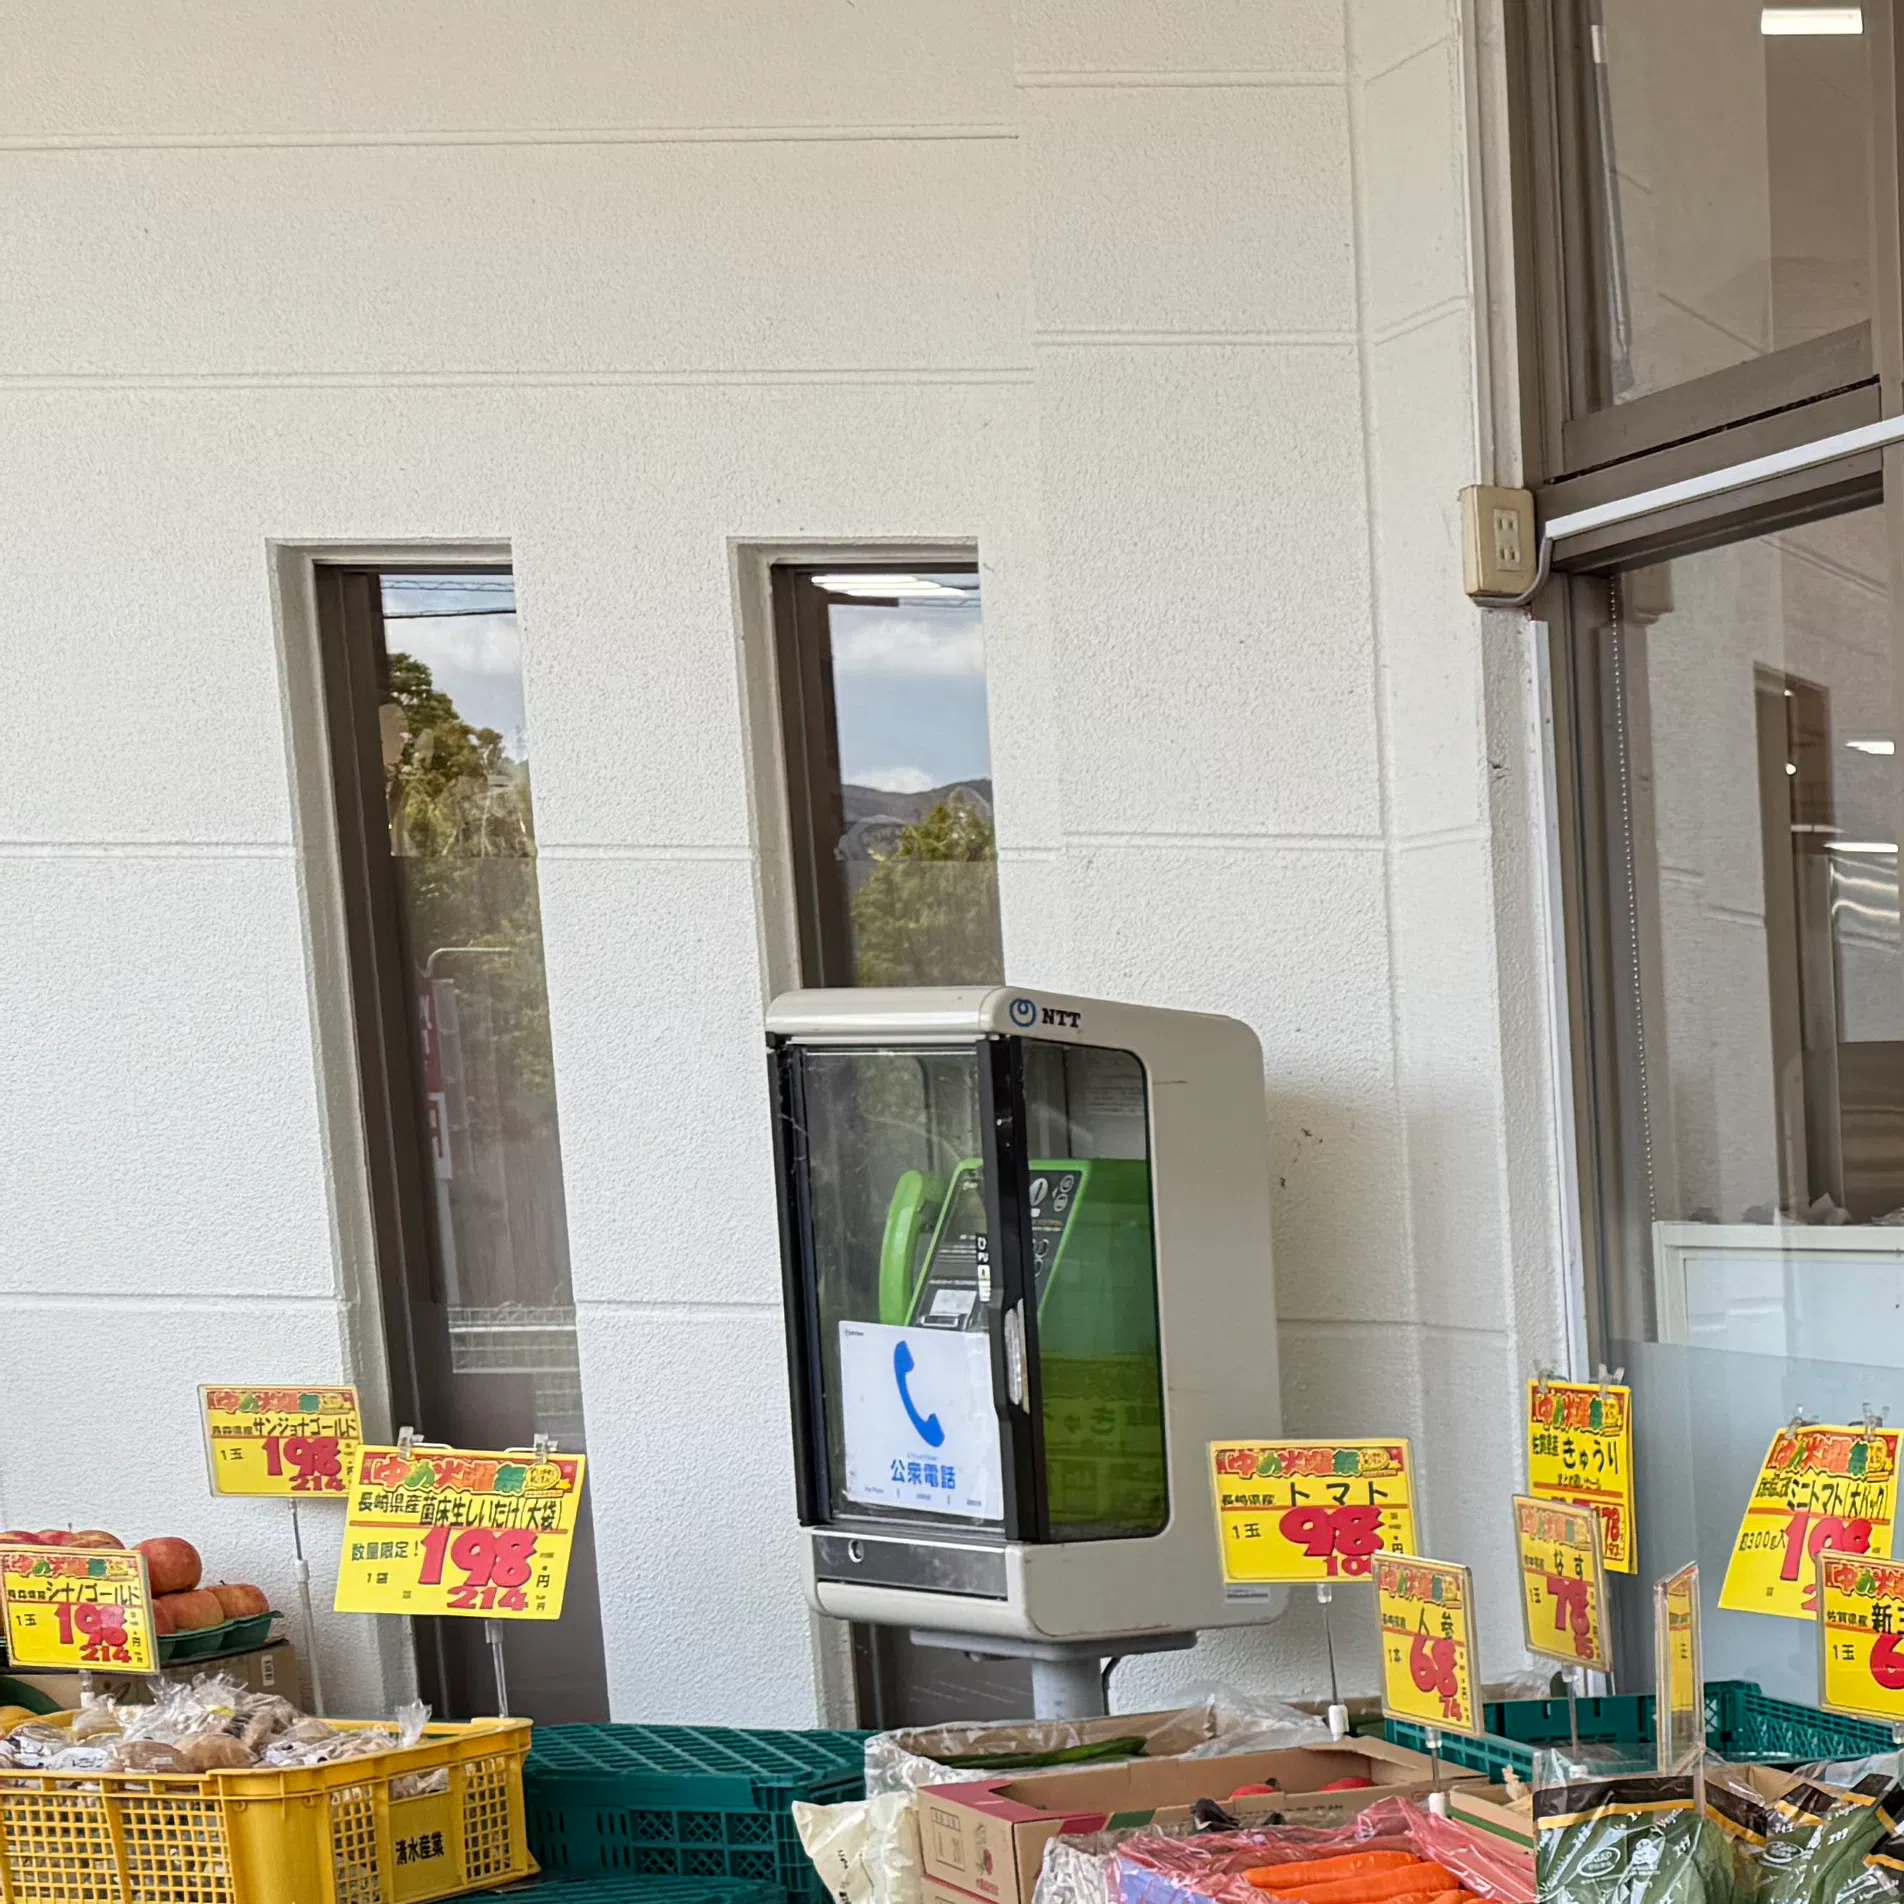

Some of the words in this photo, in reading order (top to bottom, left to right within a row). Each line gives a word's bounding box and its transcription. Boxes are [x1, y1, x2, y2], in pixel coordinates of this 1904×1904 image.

[1042, 1008, 1081, 1028] NTT
[253, 1417, 357, 1437] サンジョナゴールド
[221, 1448, 244, 1460] 1玉
[262, 1437, 342, 1476] 198
[1563, 1438, 1618, 1474] きゅうり
[289, 1476, 346, 1491] 214
[890, 1459, 956, 1489] 公衆電話
[1290, 1481, 1389, 1507] トマト
[358, 1491, 420, 1513] 長崎県産
[420, 1494, 563, 1530] 菌床生しいたけ(大袋)
[1232, 1523, 1261, 1539] 1玉
[1279, 1506, 1385, 1556] 98
[418, 1528, 538, 1587] 198
[1553, 1549, 1584, 1581] なす
[47, 1581, 141, 1607] シナノゴールド
[447, 1587, 528, 1611] 214
[1547, 1576, 1590, 1636] 78
[16, 1613, 38, 1627] 1玉
[55, 1604, 128, 1646] 198
[81, 1645, 132, 1664] 214
[1410, 1634, 1458, 1697] 68
[1833, 1644, 1855, 1661] 1玉
